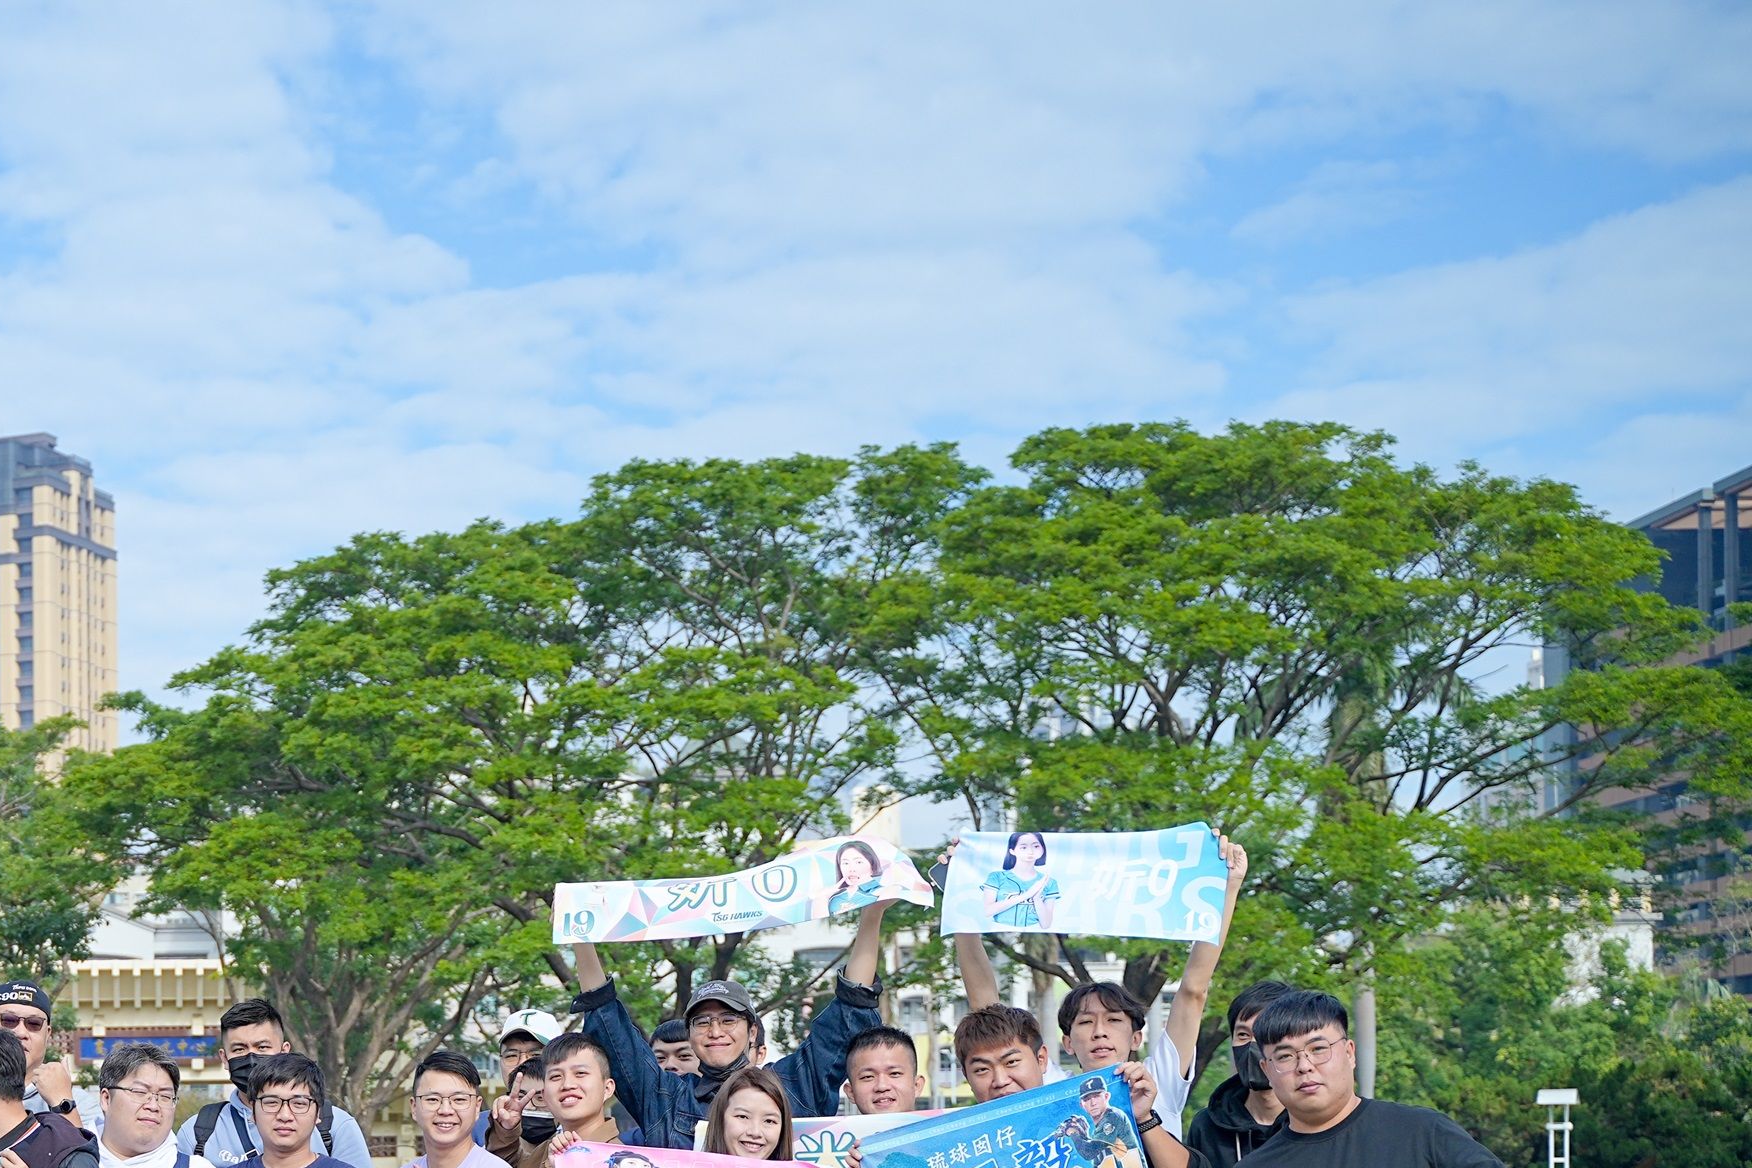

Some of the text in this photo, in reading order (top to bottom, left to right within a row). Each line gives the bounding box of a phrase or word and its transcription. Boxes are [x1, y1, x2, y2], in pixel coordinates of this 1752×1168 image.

[563, 910, 595, 936] 19
[712, 911, 729, 922] TSG
[730, 910, 764, 920] HAWKS
[1182, 909, 1222, 939] 19
